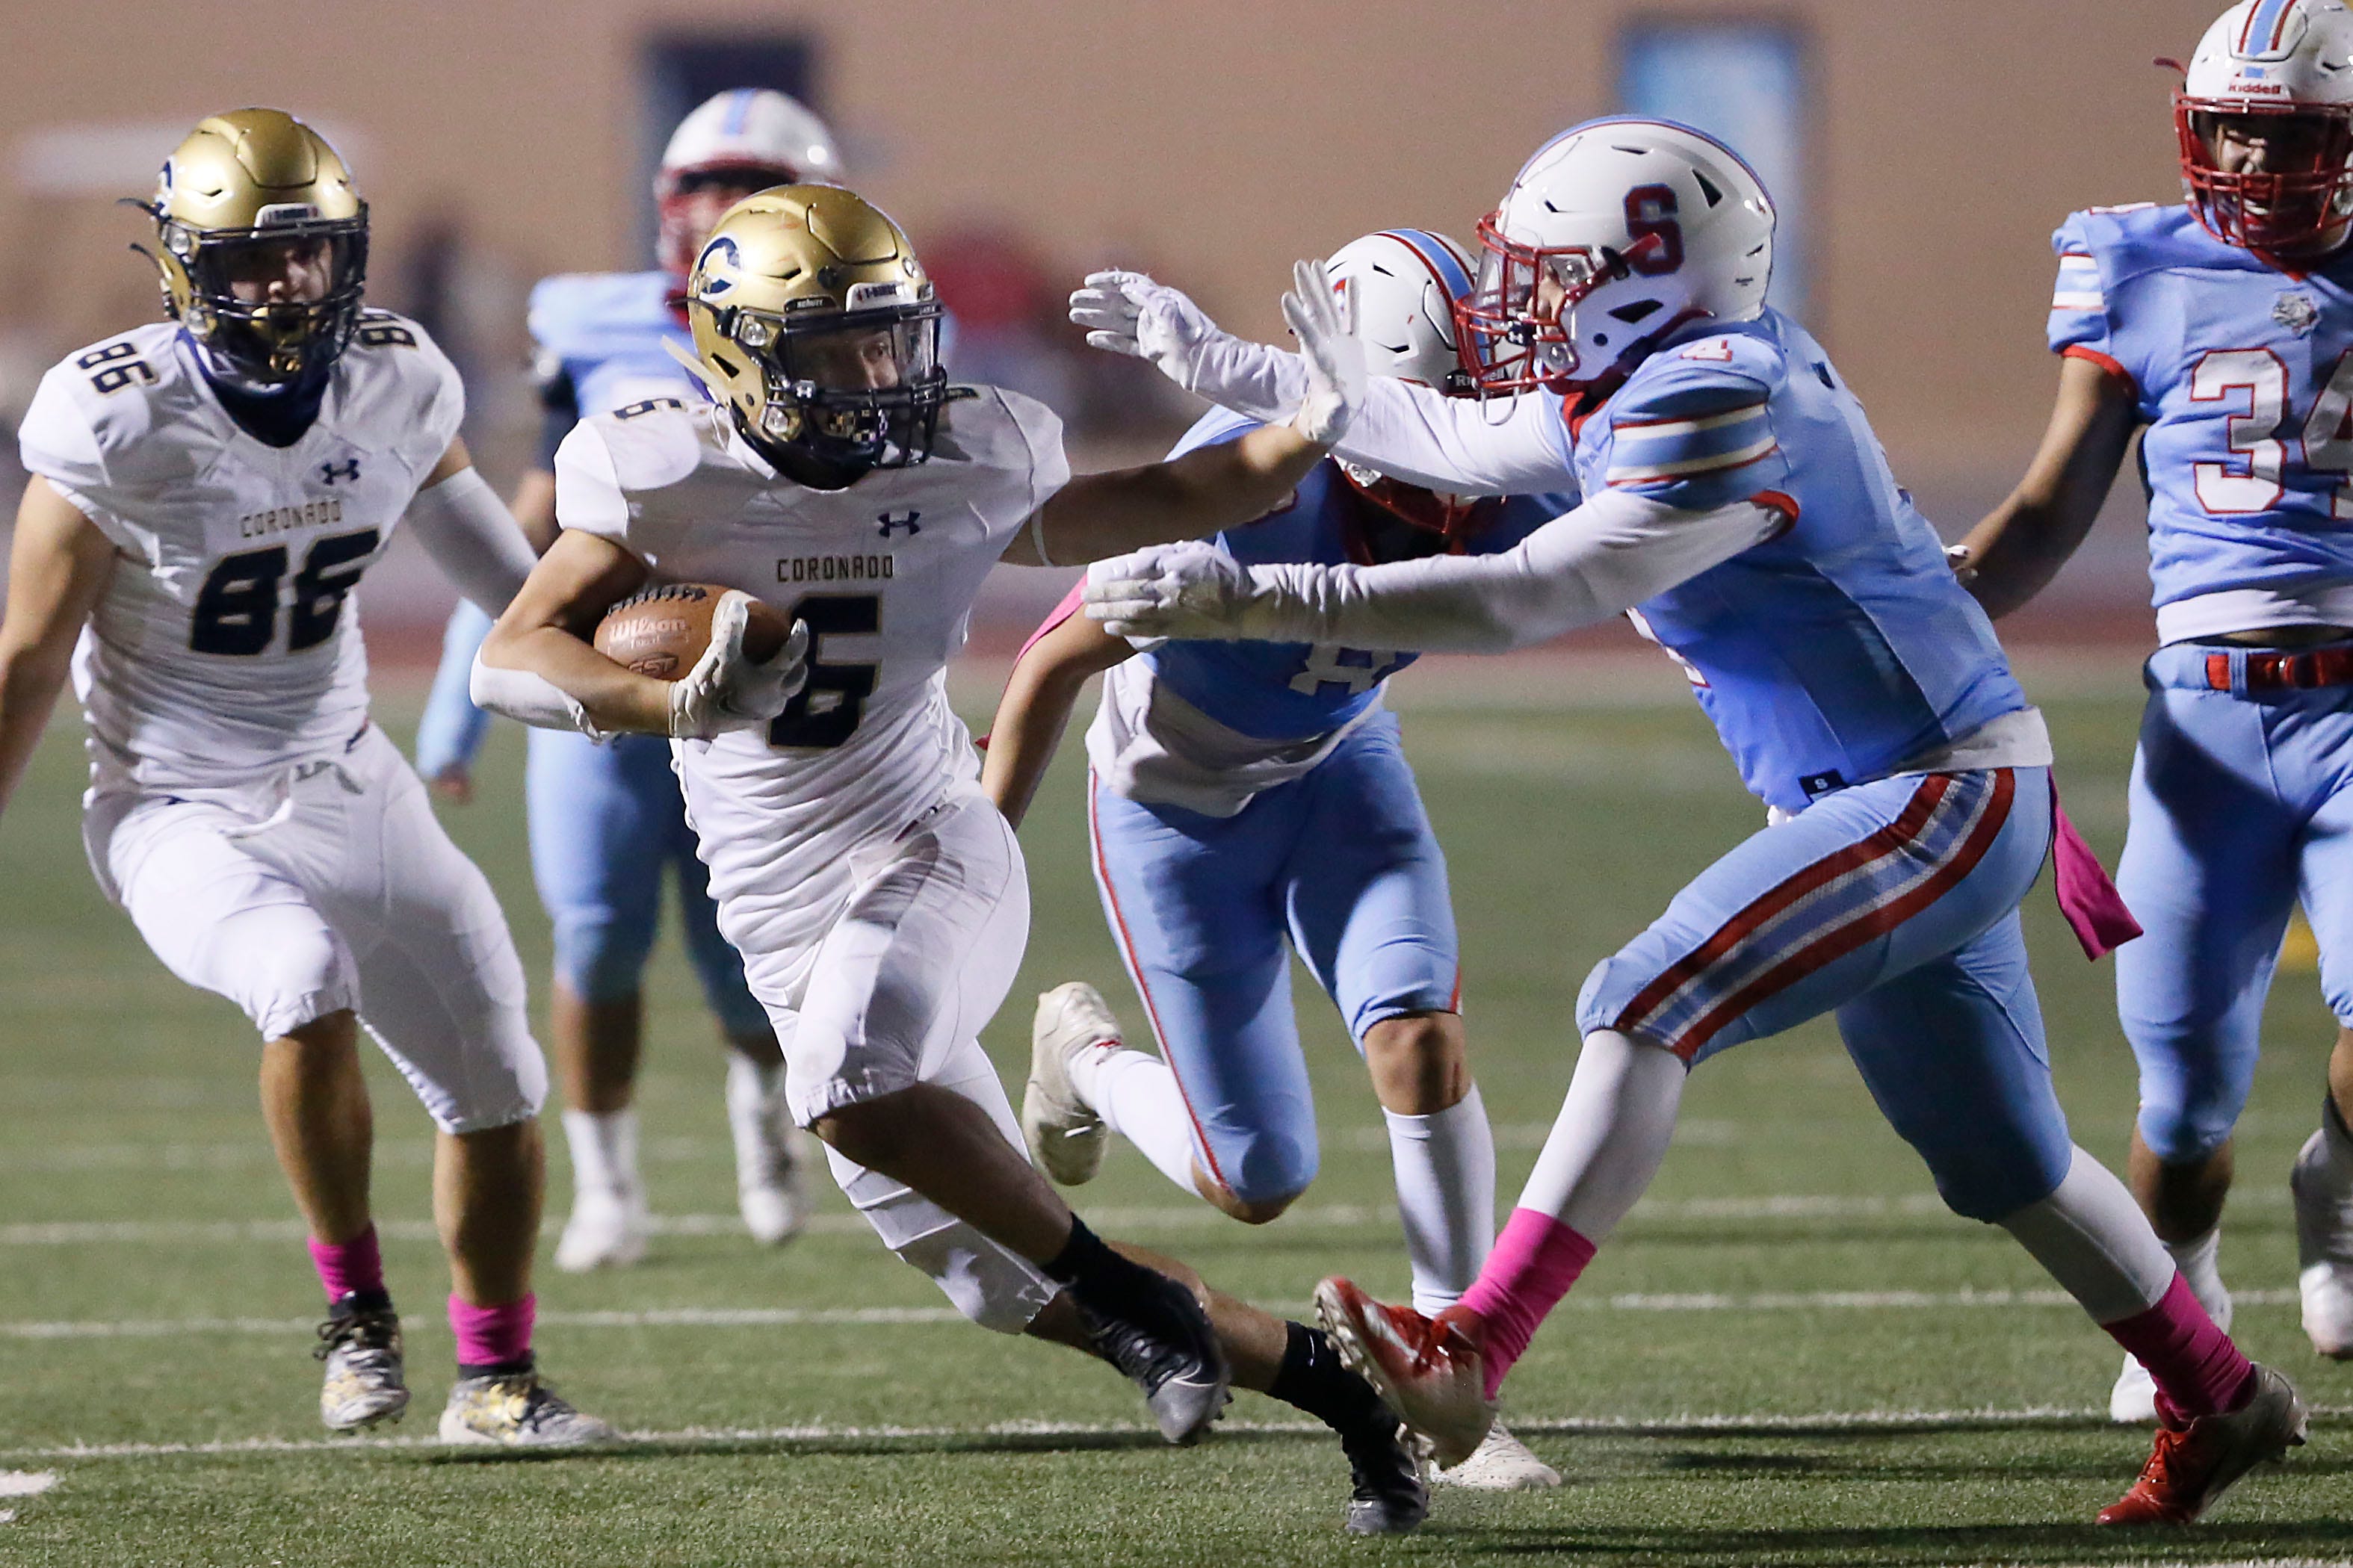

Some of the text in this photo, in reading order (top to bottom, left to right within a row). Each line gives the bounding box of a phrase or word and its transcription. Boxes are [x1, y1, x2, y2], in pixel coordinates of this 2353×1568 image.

[1622, 182, 1685, 278] S
[697, 232, 744, 302] C
[75, 341, 161, 396] 86
[1678, 338, 1733, 362] 4
[241, 499, 342, 539] CORONADO
[189, 522, 383, 657] 86
[776, 553, 894, 583] CORONADO
[609, 618, 687, 642] Wilson
[765, 589, 884, 752] 6
